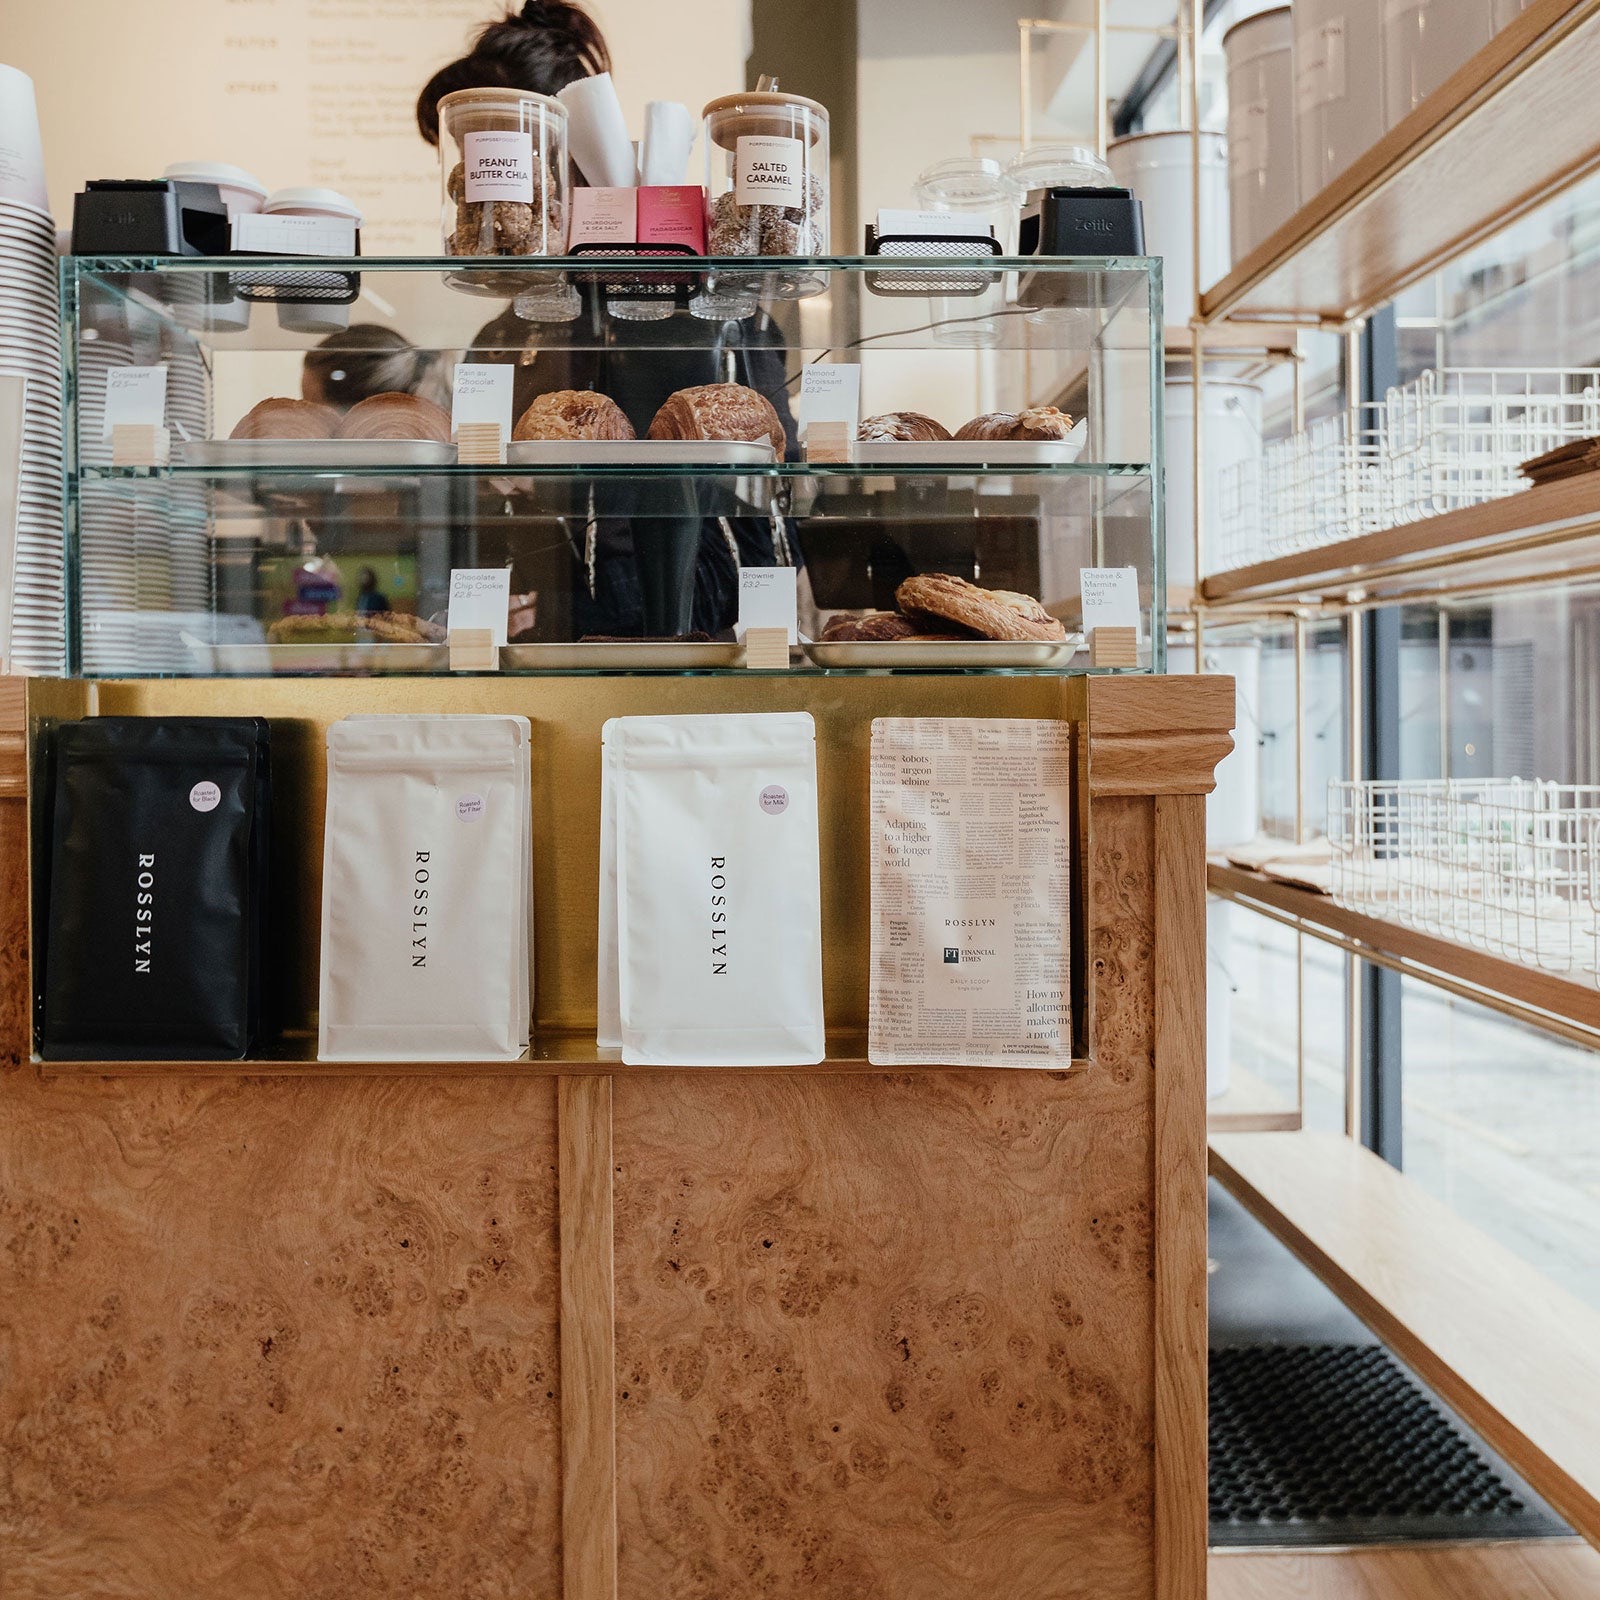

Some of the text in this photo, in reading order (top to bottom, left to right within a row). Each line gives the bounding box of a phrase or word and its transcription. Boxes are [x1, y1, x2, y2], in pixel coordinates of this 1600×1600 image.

[479, 158, 518, 168] PEANUT
[752, 162, 788, 172] SALTED
[470, 170, 528, 180] BUTTER CHIA
[746, 174, 792, 186] CARAMEL
[1074, 218, 1114, 231] Zettle
[111, 370, 150, 378] Croissant
[458, 369, 475, 377] Pain
[805, 369, 836, 377] Almond
[458, 378, 495, 386] Chocolat
[455, 573, 496, 581] Chocolate
[454, 582, 504, 590] Chip Cookie
[460, 800, 481, 808] Roasted
[885, 819, 927, 831] Adapting
[884, 833, 893, 841] to
[902, 832, 931, 843] higher
[884, 858, 910, 867] world
[135, 853, 155, 974] ROSSLYN
[411, 851, 430, 968] ROSSLYN
[711, 856, 727, 975] ROSSLYN
[945, 919, 995, 927] ROSSLYN
[945, 949, 959, 958] FT
[1026, 989, 1065, 1001] How my
[1026, 1016, 1056, 1026] makes
[1034, 1028, 1060, 1039] profit
